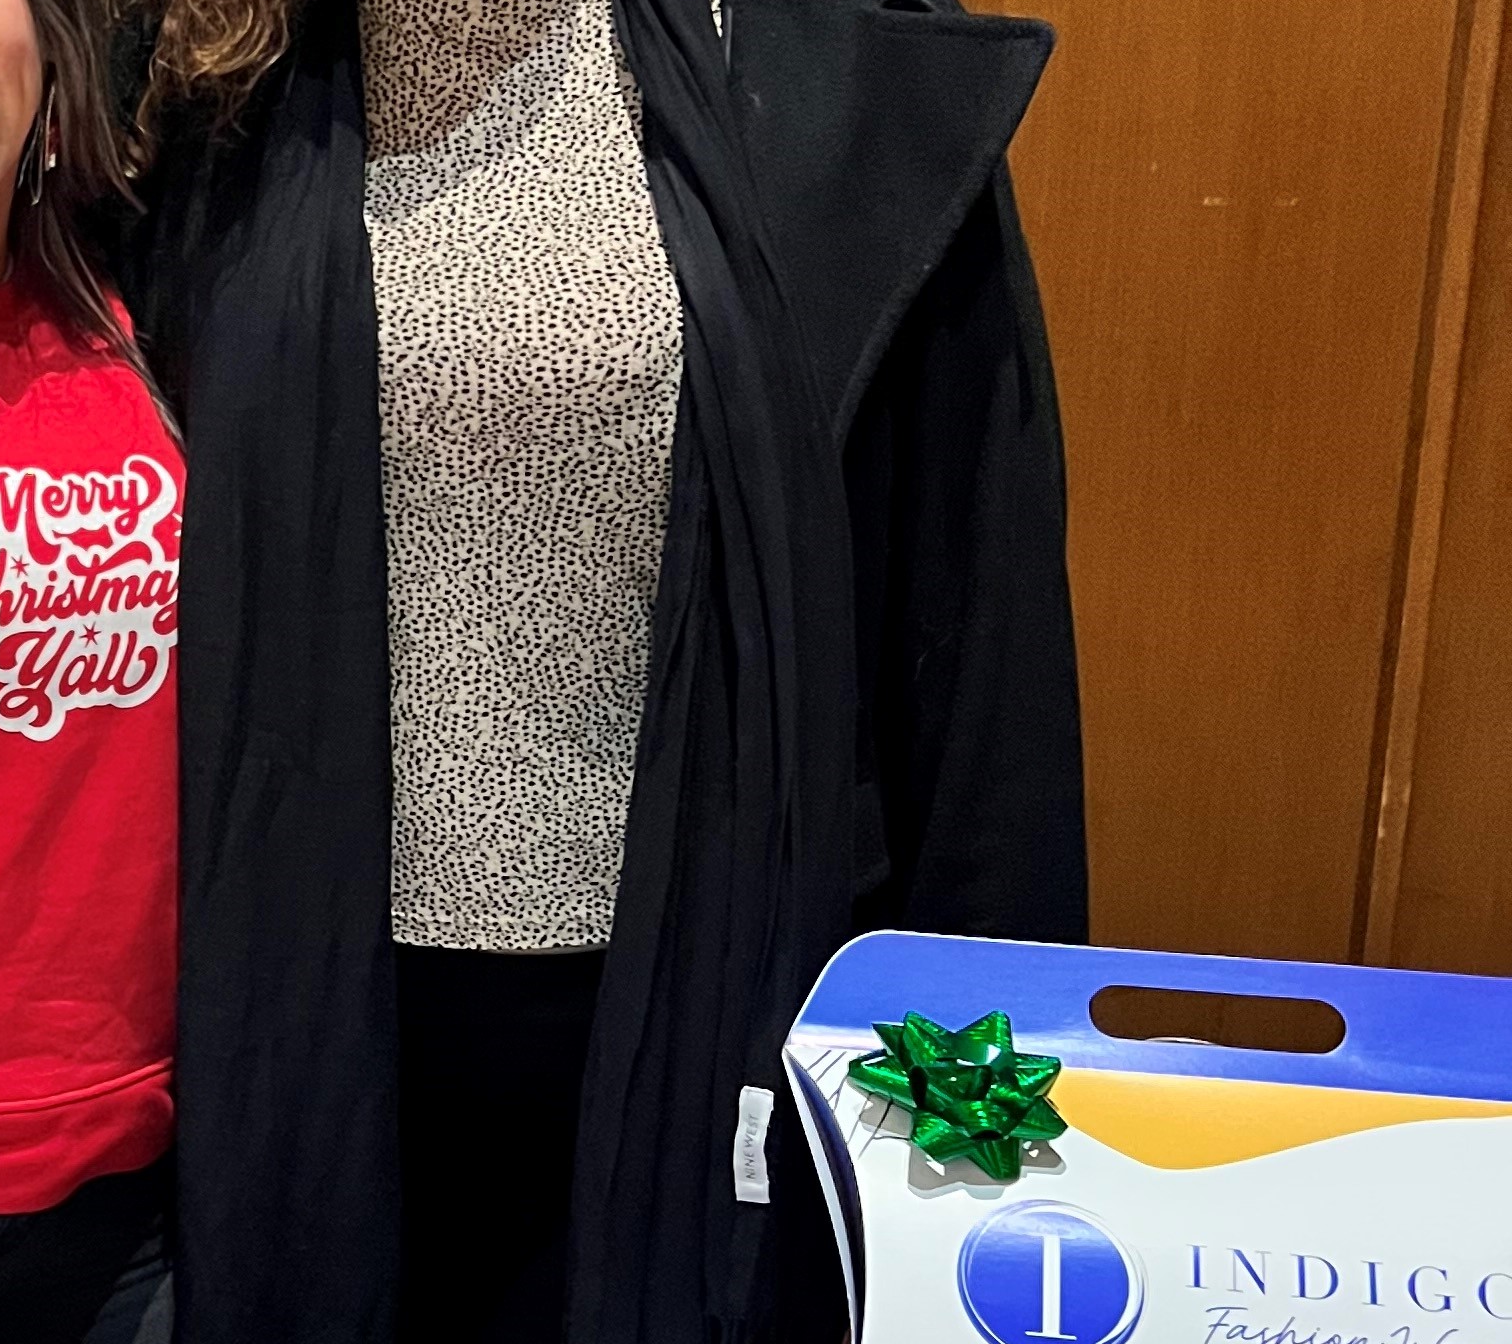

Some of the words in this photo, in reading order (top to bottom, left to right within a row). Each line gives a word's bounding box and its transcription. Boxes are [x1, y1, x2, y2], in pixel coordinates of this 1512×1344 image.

[744, 1114, 760, 1149] WEST
[744, 1151, 757, 1180] NINE
[1185, 1244, 1512, 1320] INDIGO
